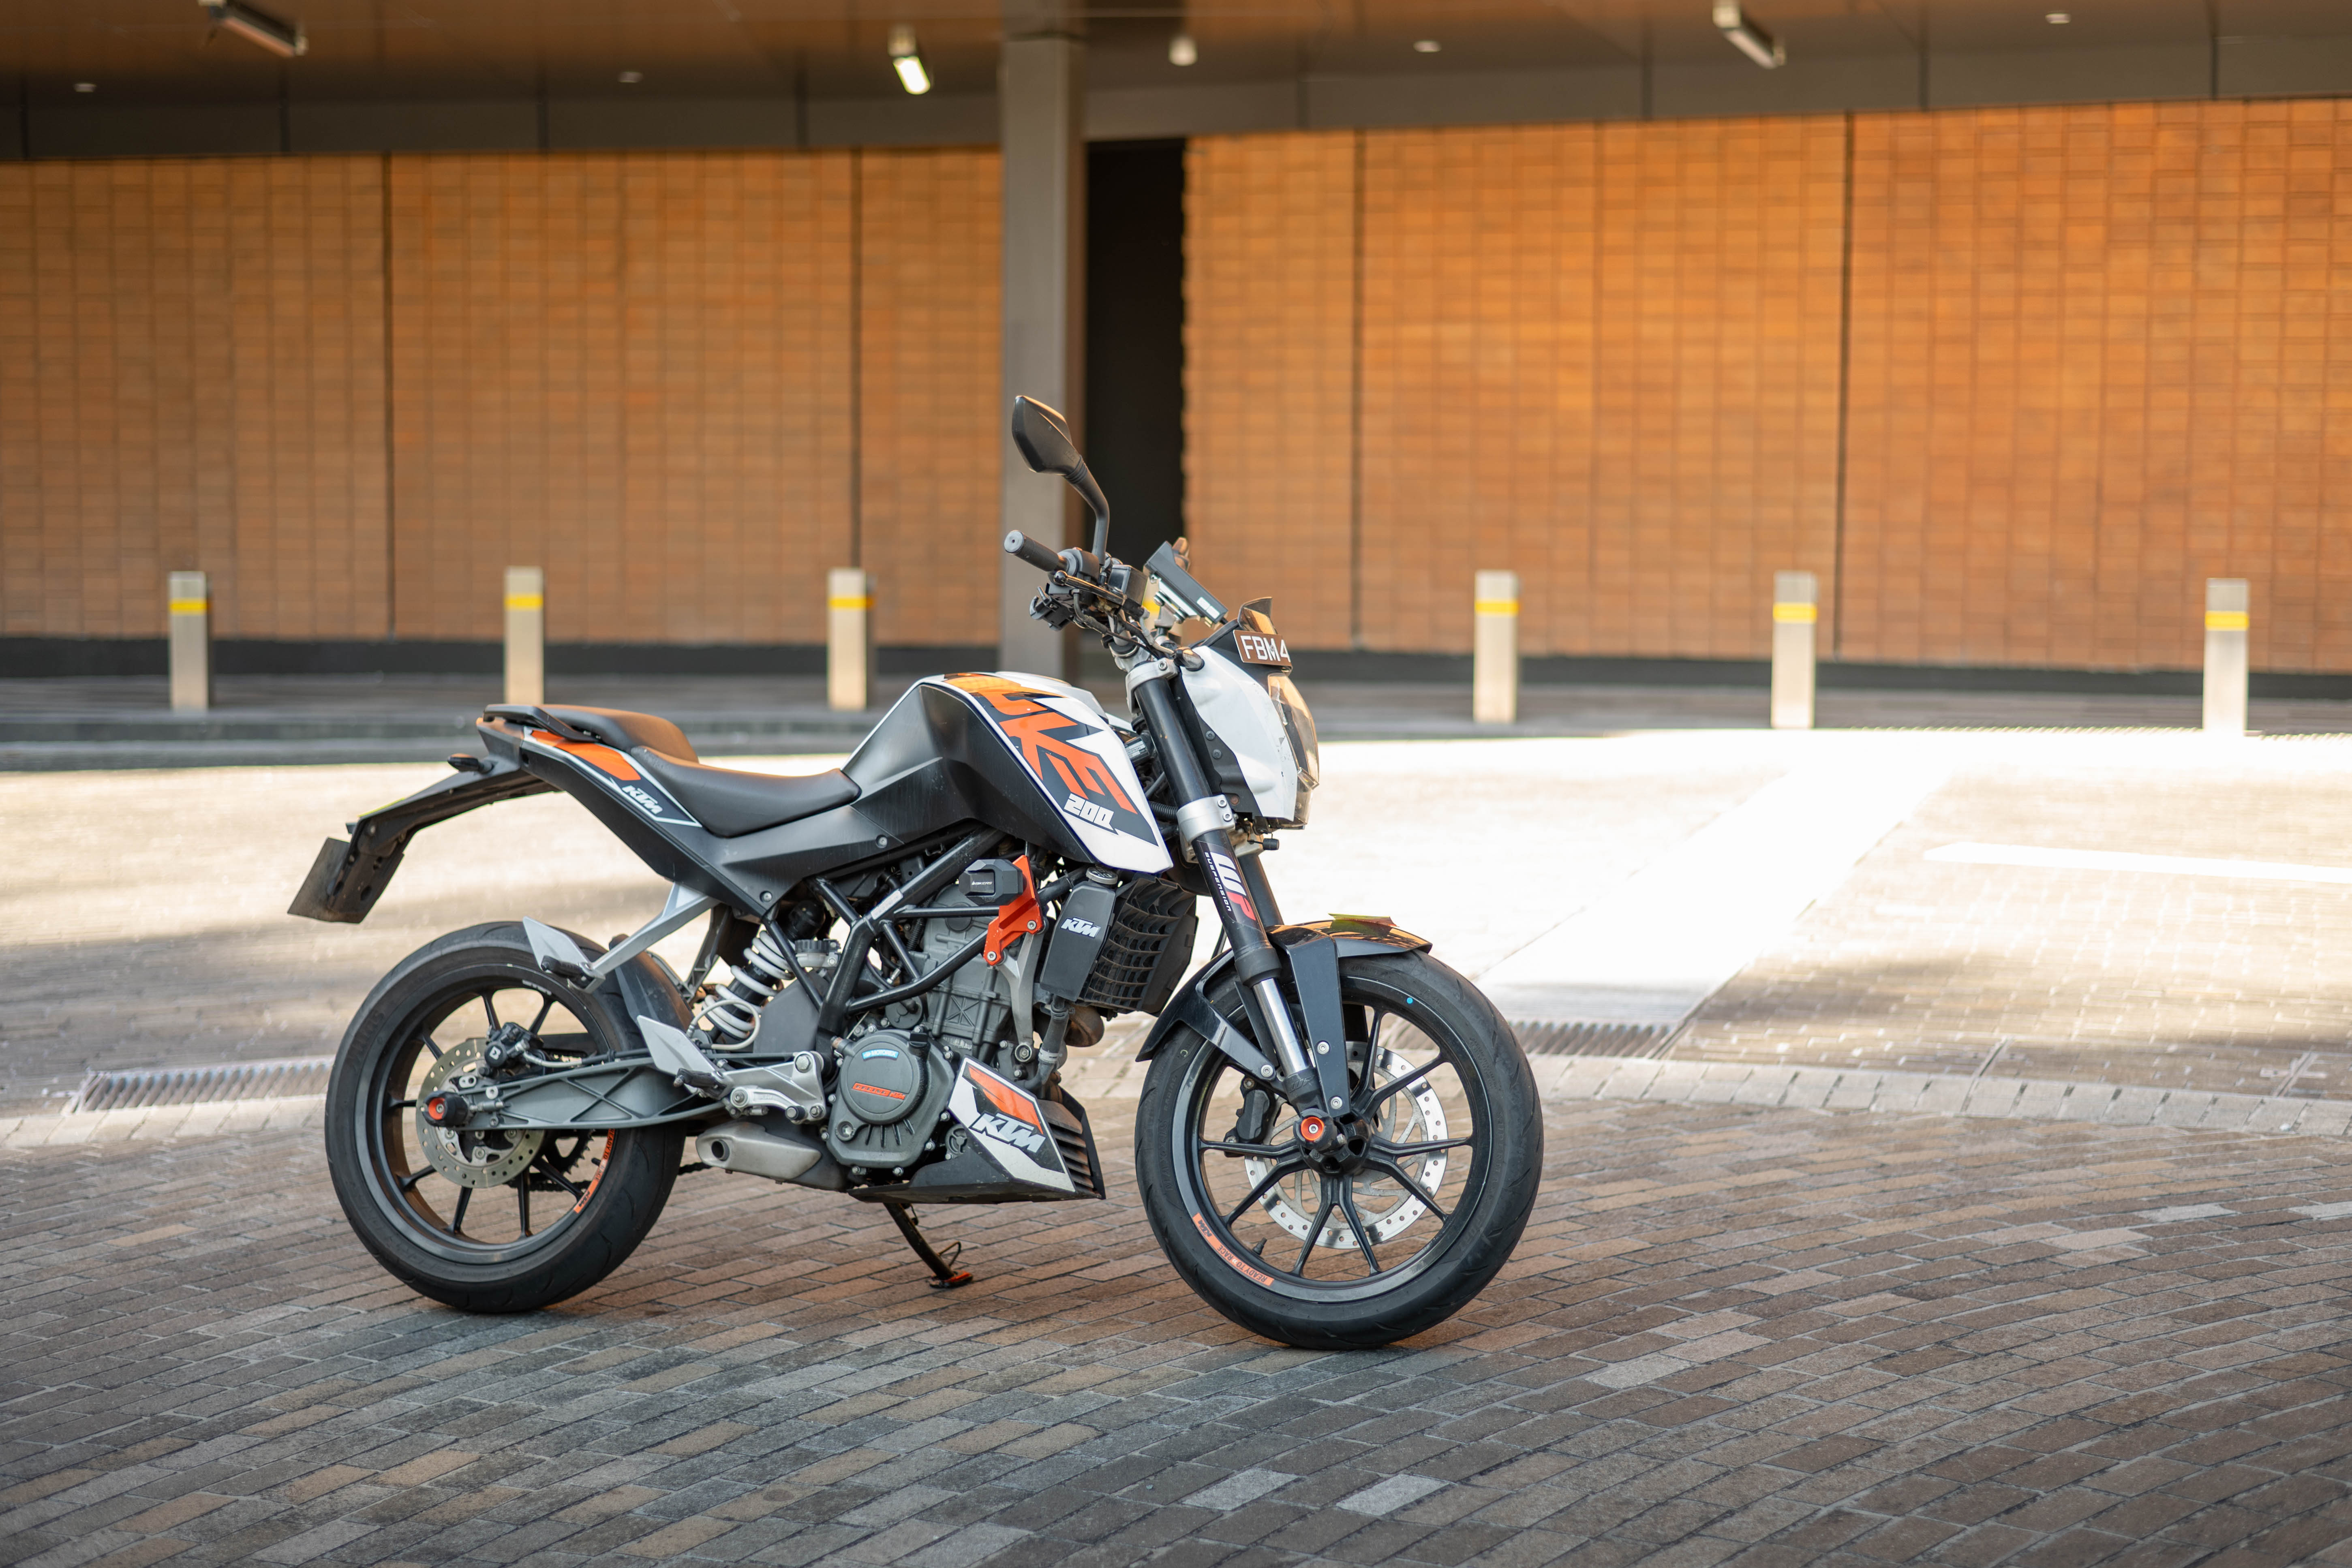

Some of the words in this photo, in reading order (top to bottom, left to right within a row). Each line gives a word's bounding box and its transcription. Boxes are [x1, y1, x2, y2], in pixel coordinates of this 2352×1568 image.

[1240, 635, 1291, 663] FBM4
[952, 674, 1138, 815] UKE
[622, 785, 663, 814] KTM
[1064, 793, 1114, 830] 200
[1061, 917, 1101, 938] KTM
[973, 1113, 1046, 1153] KTM
[1198, 1219, 1212, 1237] KTM
[1217, 1245, 1234, 1261] RACE
[1236, 1261, 1246, 1271] TO
[1244, 1268, 1267, 1282] READY
